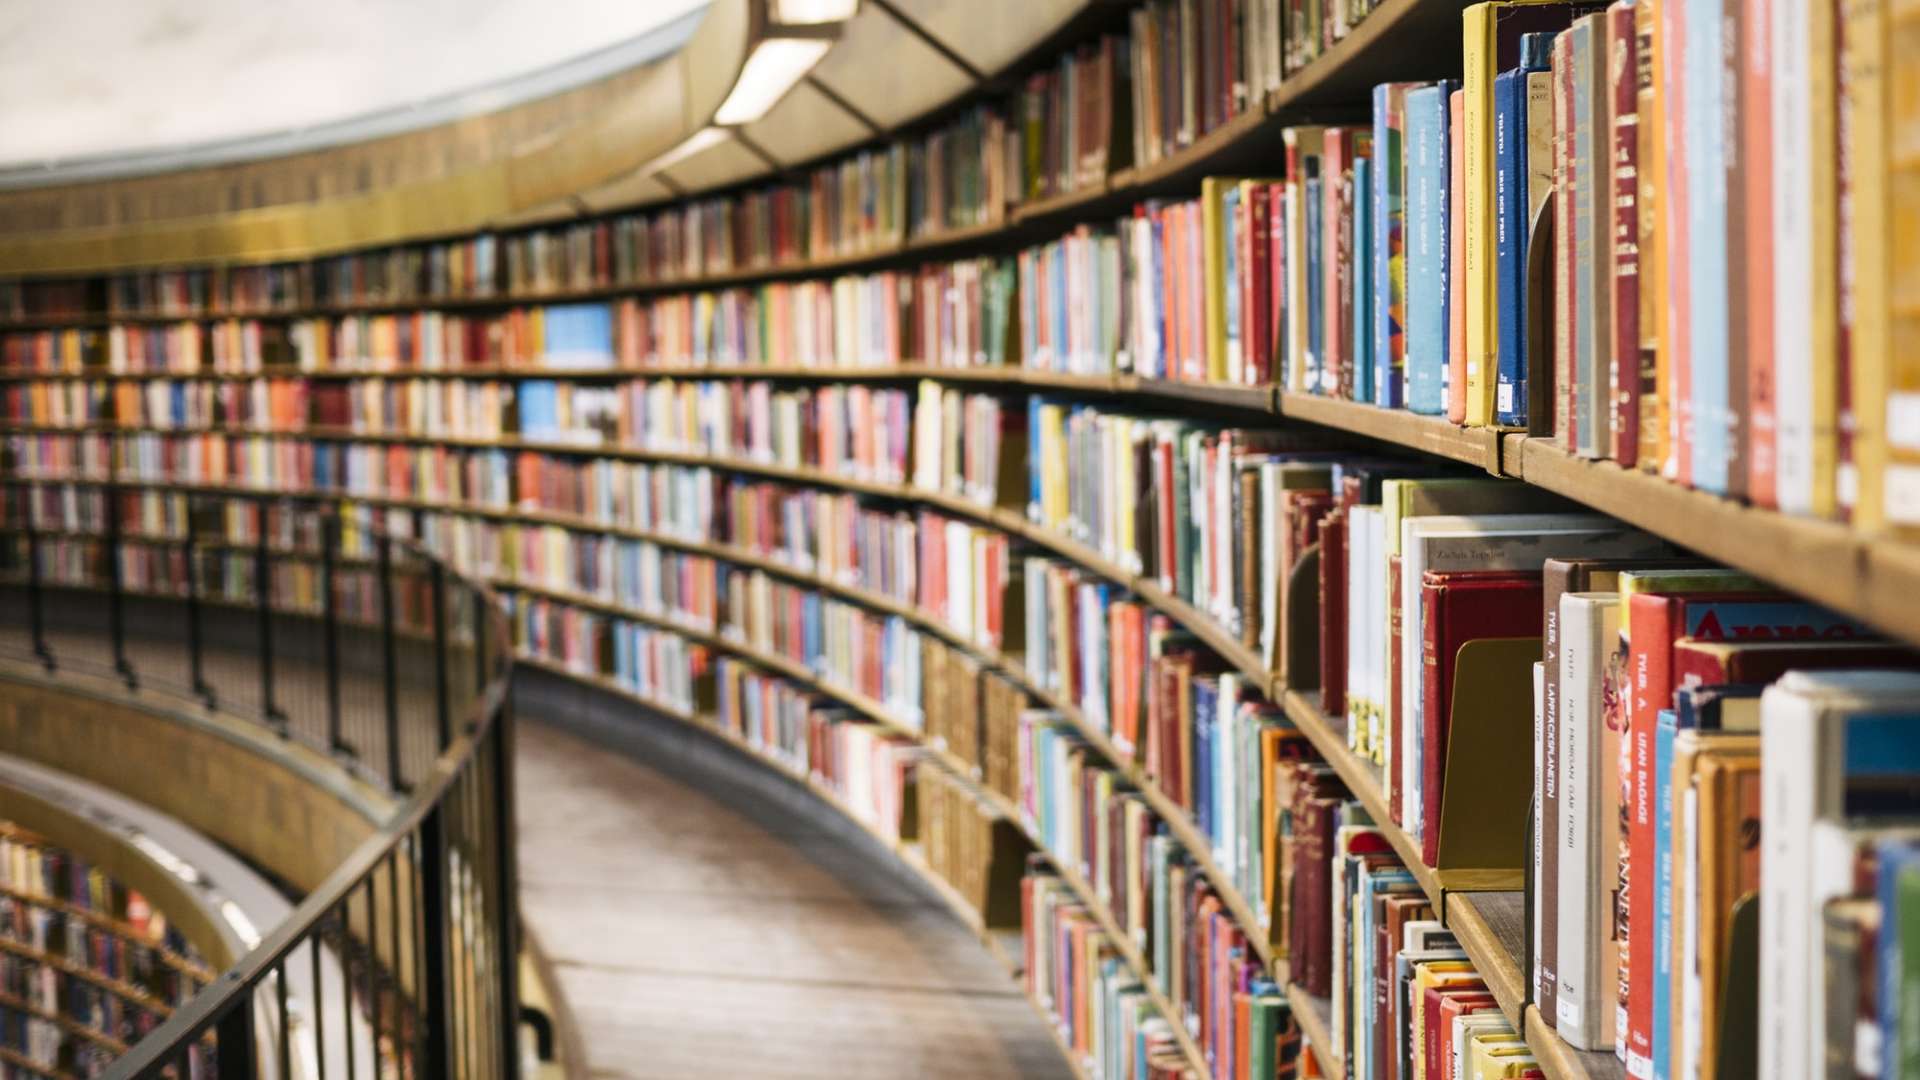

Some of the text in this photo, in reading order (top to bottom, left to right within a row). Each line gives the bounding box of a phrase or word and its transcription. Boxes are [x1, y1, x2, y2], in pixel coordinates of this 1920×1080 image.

[1547, 610, 1556, 645] TYLER,
[1637, 732, 1648, 824] UTAN BAGAGE
[1619, 841, 1631, 996] ANNE TYLER
